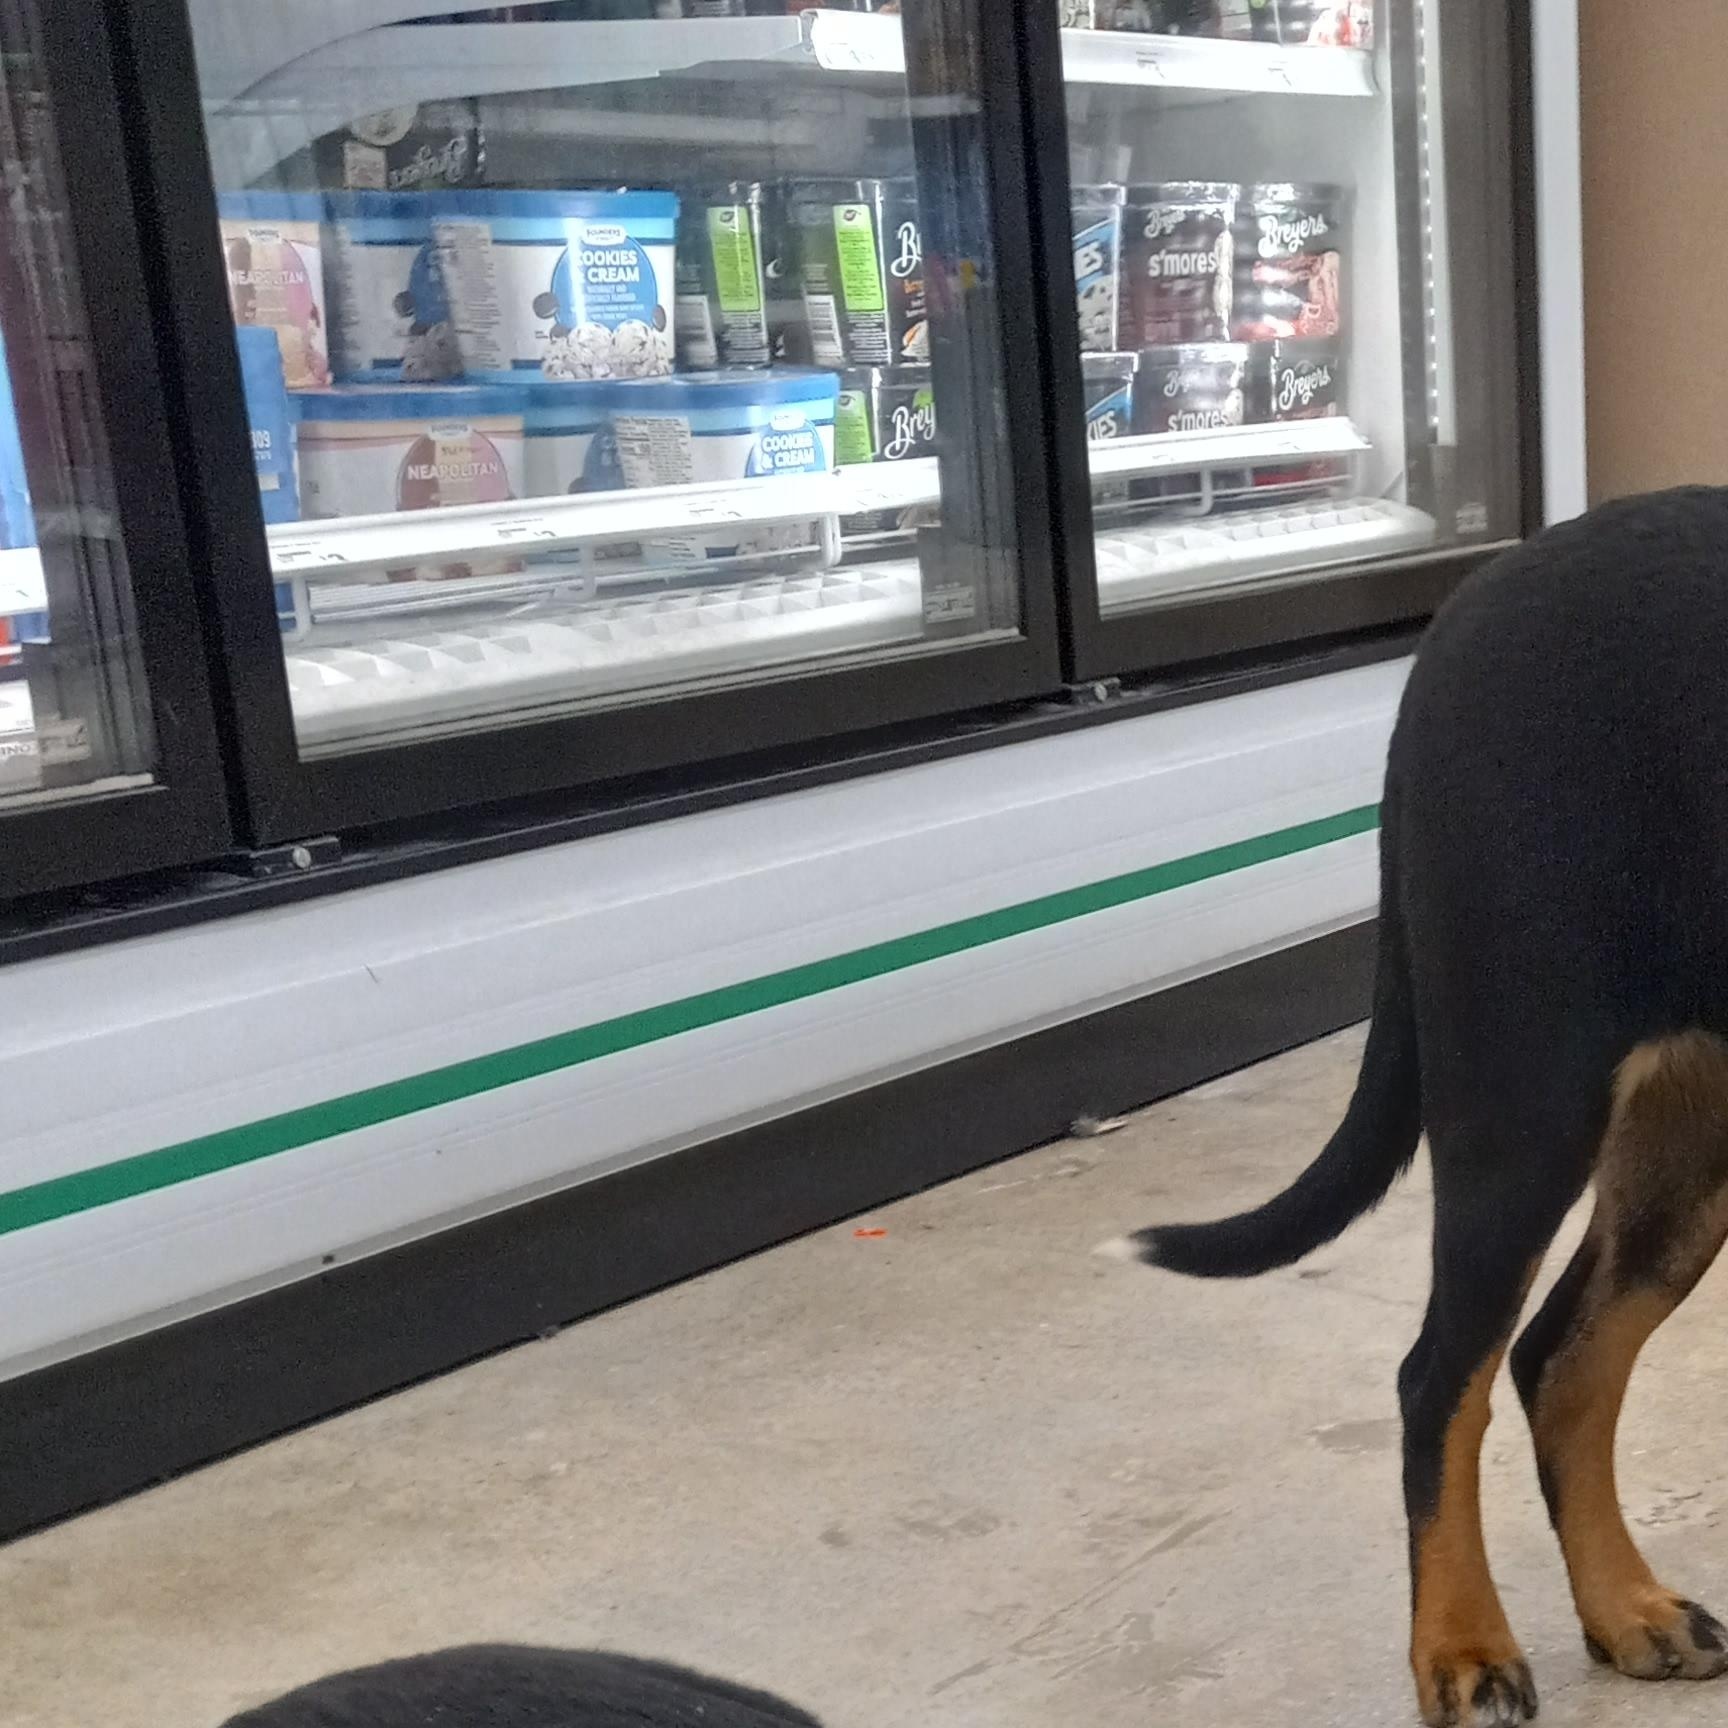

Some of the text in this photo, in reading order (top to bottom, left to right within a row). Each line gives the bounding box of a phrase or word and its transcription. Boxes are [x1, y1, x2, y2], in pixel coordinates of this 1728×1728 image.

[1257, 213, 1328, 258] Breyers
[577, 249, 638, 266] OOKIES
[1149, 249, 1217, 277] s'mores
[587, 266, 640, 283] CREAM
[1279, 365, 1331, 411] Breyers
[407, 461, 498, 481] NEAPOLITAN
